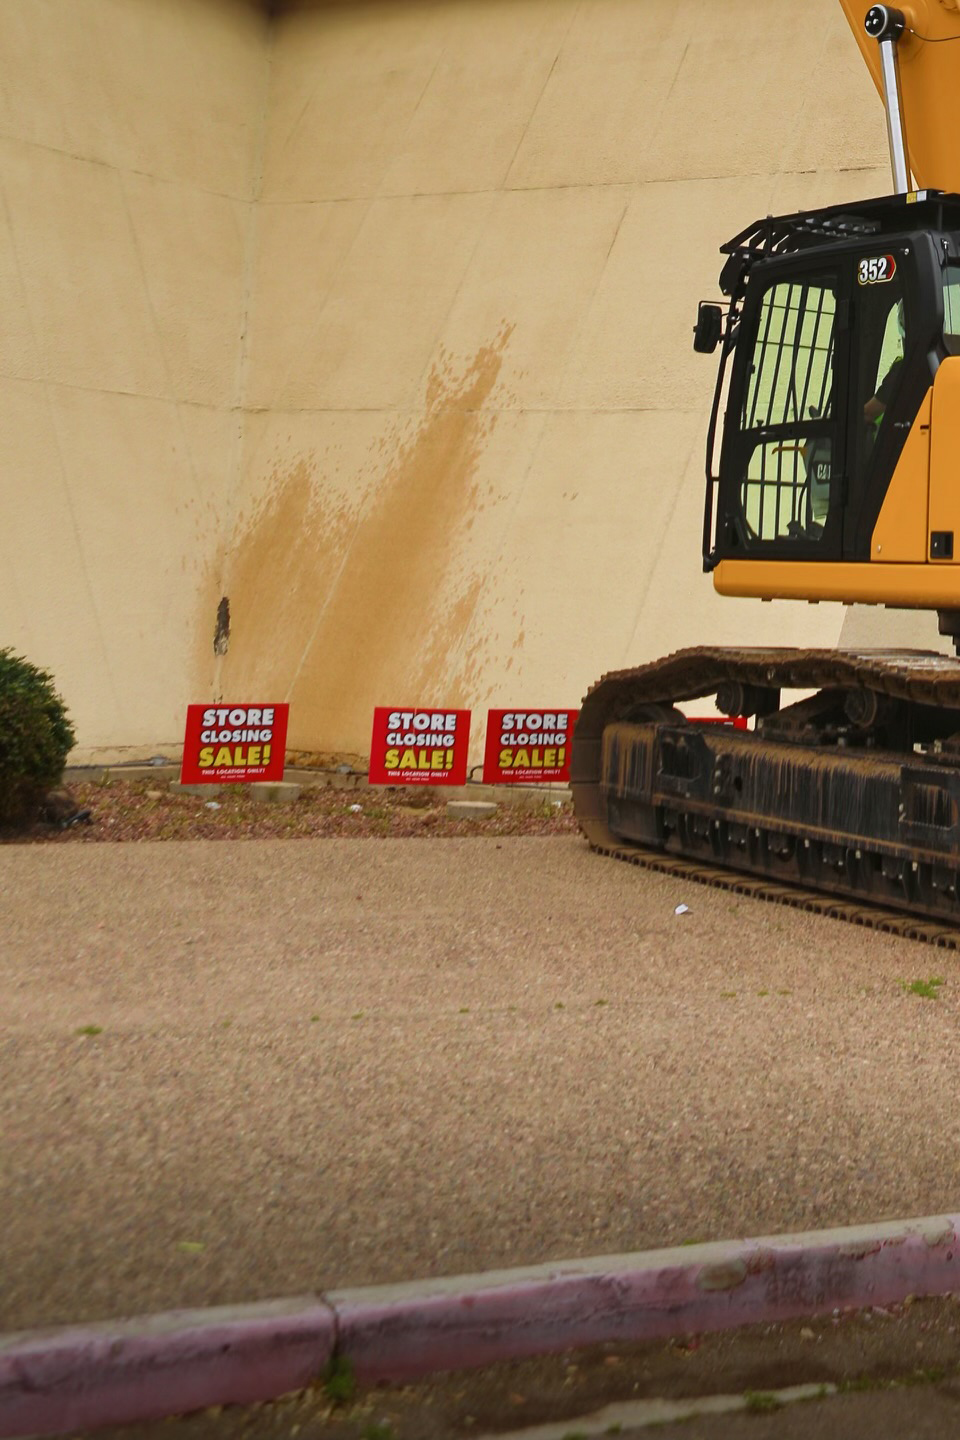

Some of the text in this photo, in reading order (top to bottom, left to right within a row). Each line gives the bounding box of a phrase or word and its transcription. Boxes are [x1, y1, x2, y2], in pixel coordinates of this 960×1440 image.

[859, 257, 888, 282] 352
[202, 708, 274, 727] STORE
[387, 712, 457, 731] STORE
[501, 713, 569, 730] STORE
[200, 729, 272, 744] CLOSING
[386, 732, 455, 747] CLOSING
[500, 733, 567, 746] CLOSING
[198, 744, 272, 767] SALE!
[384, 749, 454, 770] SALE!
[498, 747, 566, 768] SALE!
